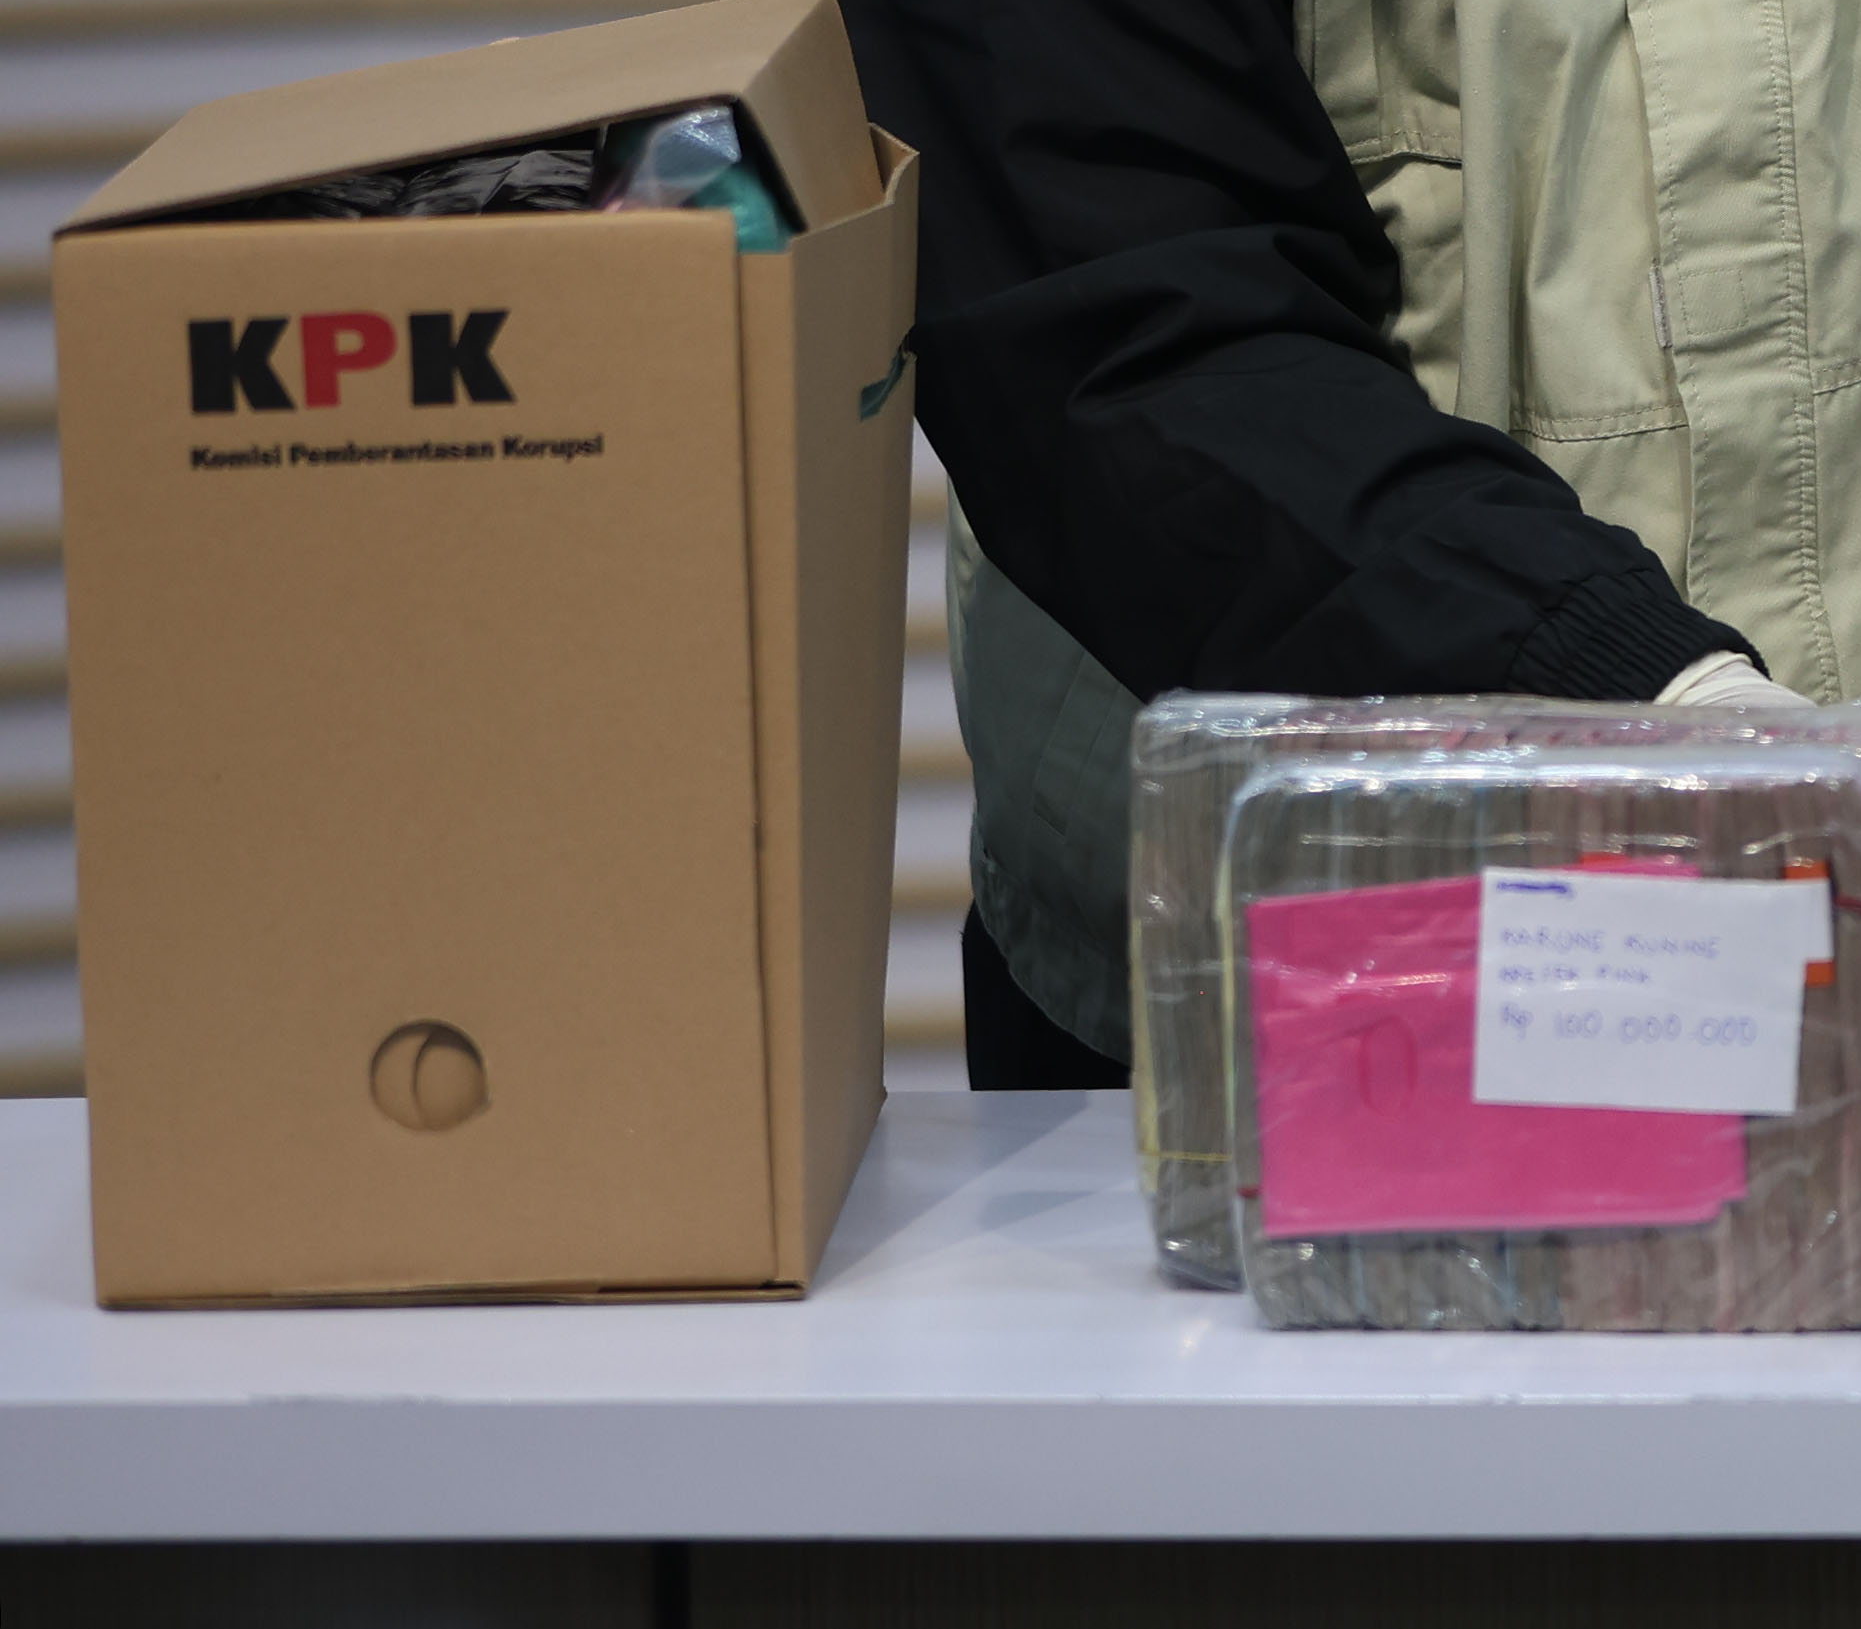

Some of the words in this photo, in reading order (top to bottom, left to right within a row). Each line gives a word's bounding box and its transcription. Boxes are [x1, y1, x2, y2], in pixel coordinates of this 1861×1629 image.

[187, 308, 518, 415] KPK
[191, 444, 282, 471] Komisi
[502, 434, 603, 463] Korupsi
